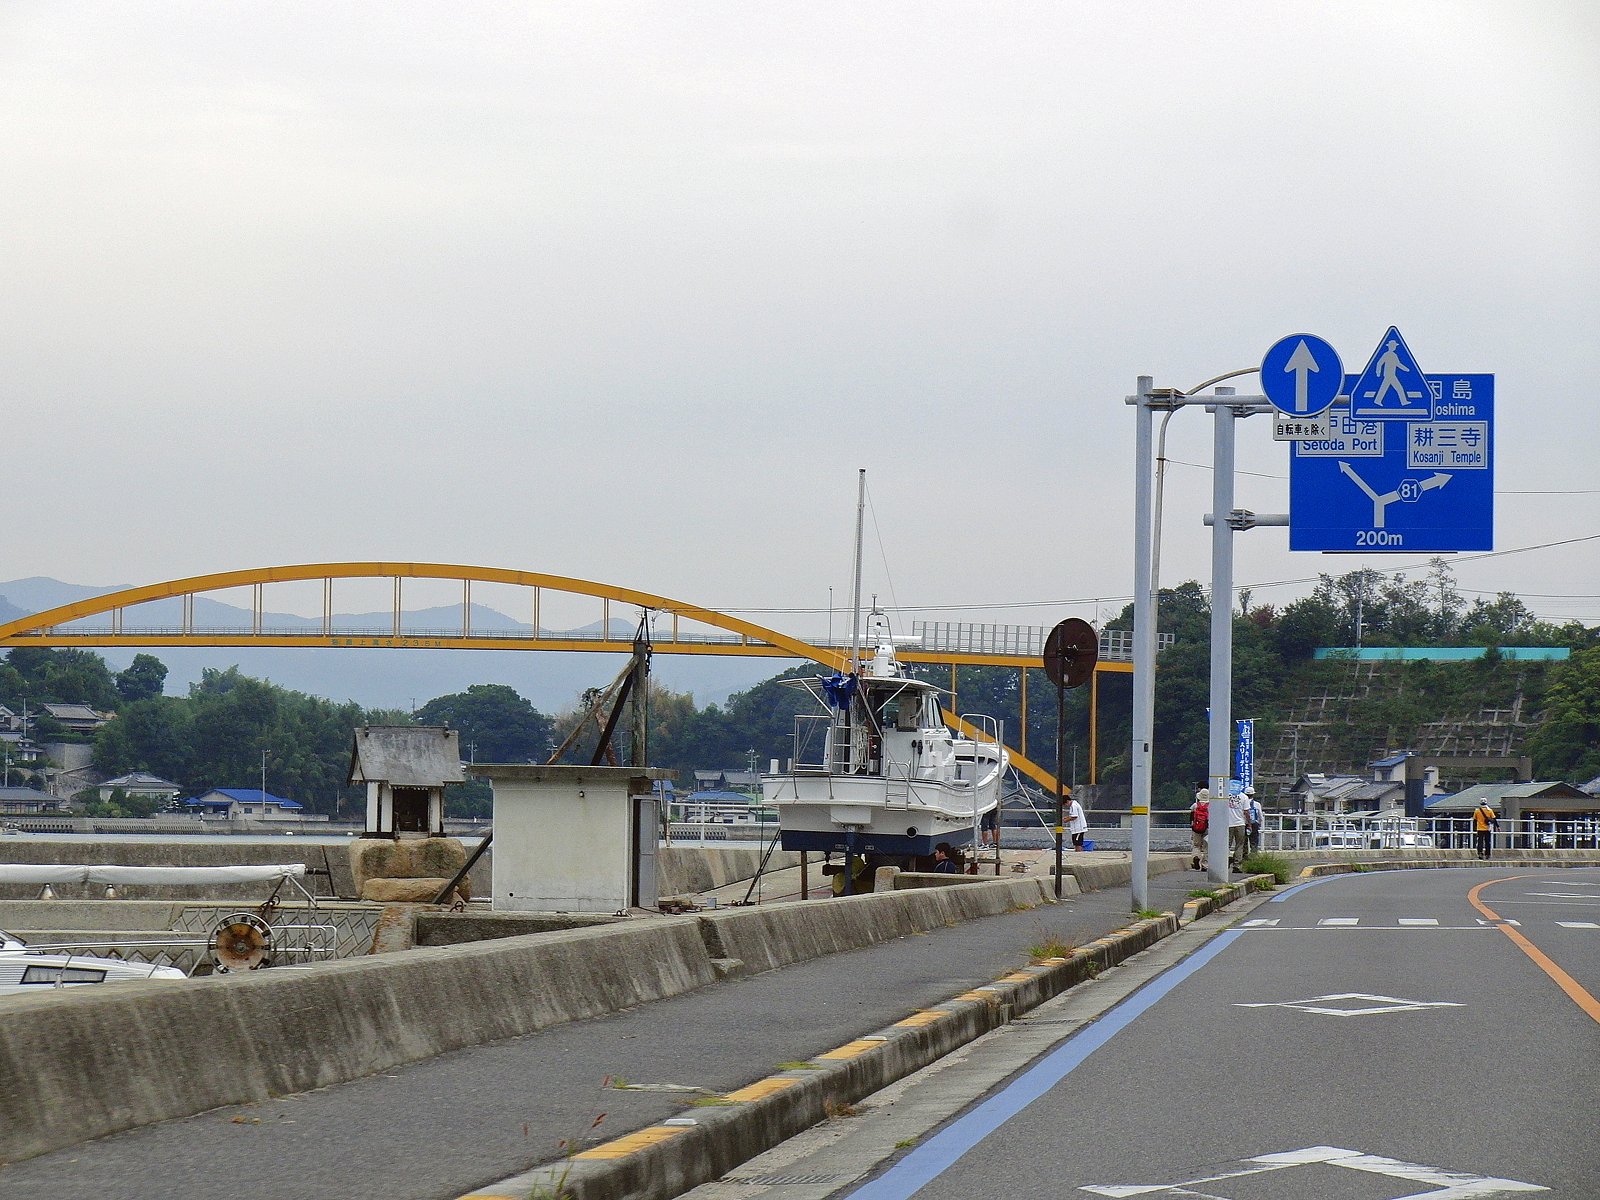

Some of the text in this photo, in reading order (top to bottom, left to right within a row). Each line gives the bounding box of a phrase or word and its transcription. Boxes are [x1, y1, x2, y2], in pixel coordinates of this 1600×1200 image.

[1435, 403, 1475, 416] oshima
[1276, 423, 1326, 436] 自転車を除く
[1414, 427, 1481, 447] 耕三寺
[1303, 438, 1377, 451] Setoda Port
[1413, 450, 1481, 465] Kosanji Temple
[1401, 484, 1418, 498] 81
[1356, 531, 1403, 546] 200m
